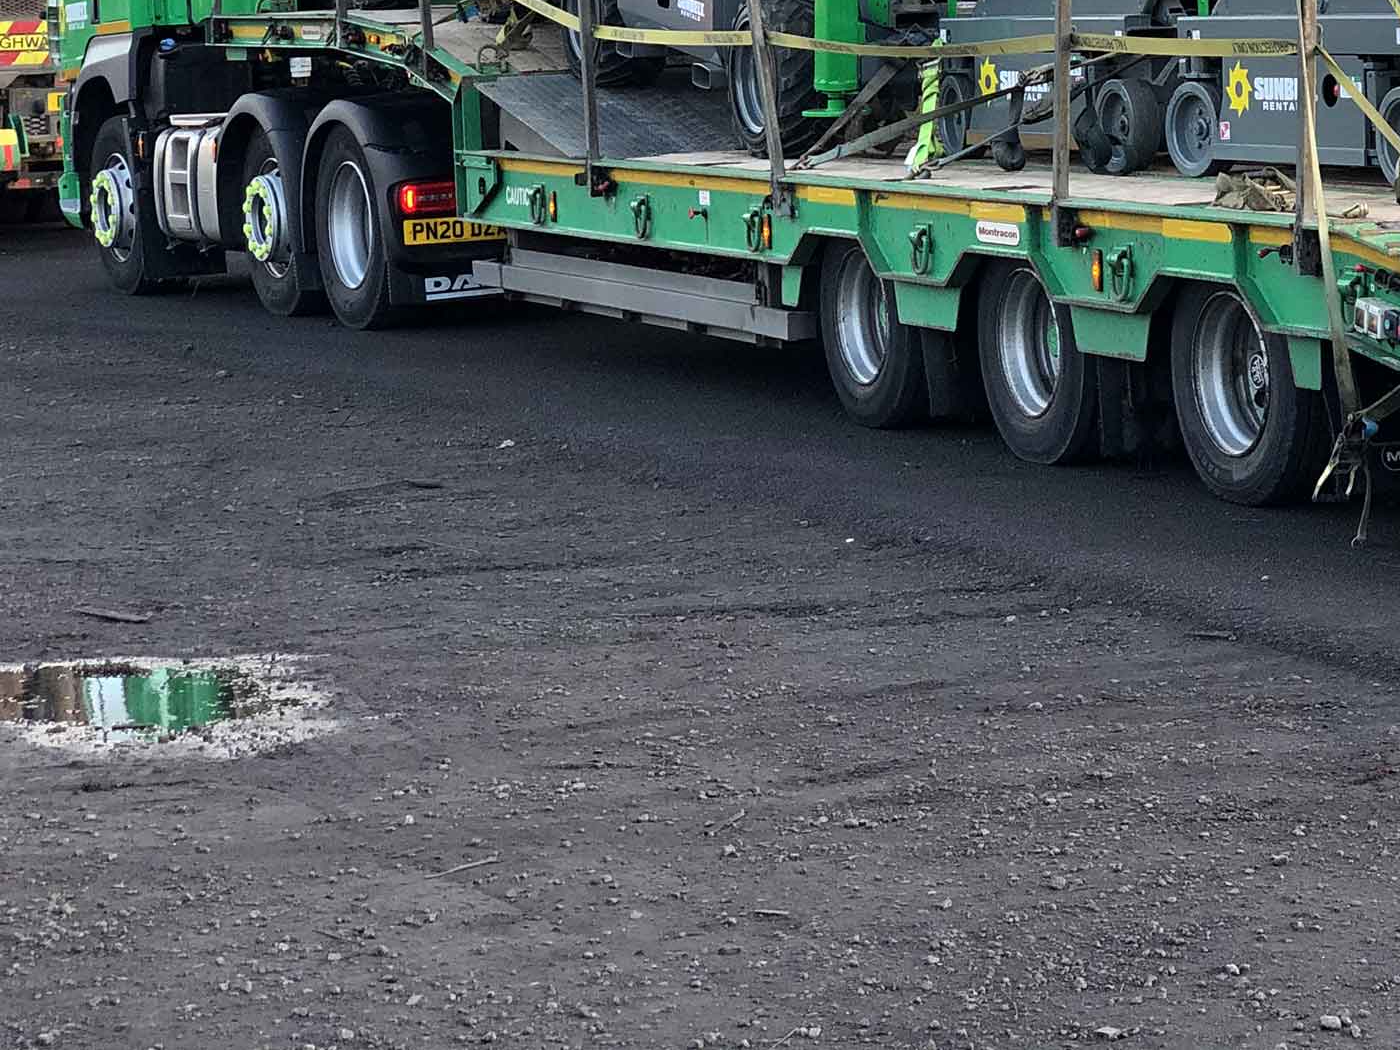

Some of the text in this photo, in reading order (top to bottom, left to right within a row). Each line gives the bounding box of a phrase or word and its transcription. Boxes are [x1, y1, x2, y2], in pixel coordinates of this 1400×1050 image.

[0, 36, 48, 49] GHWA
[1253, 77, 1298, 101] SUNB
[1262, 101, 1298, 111] RENTA
[412, 220, 464, 241] PN20
[978, 226, 1018, 239] Montracon
[424, 274, 481, 293] DA
